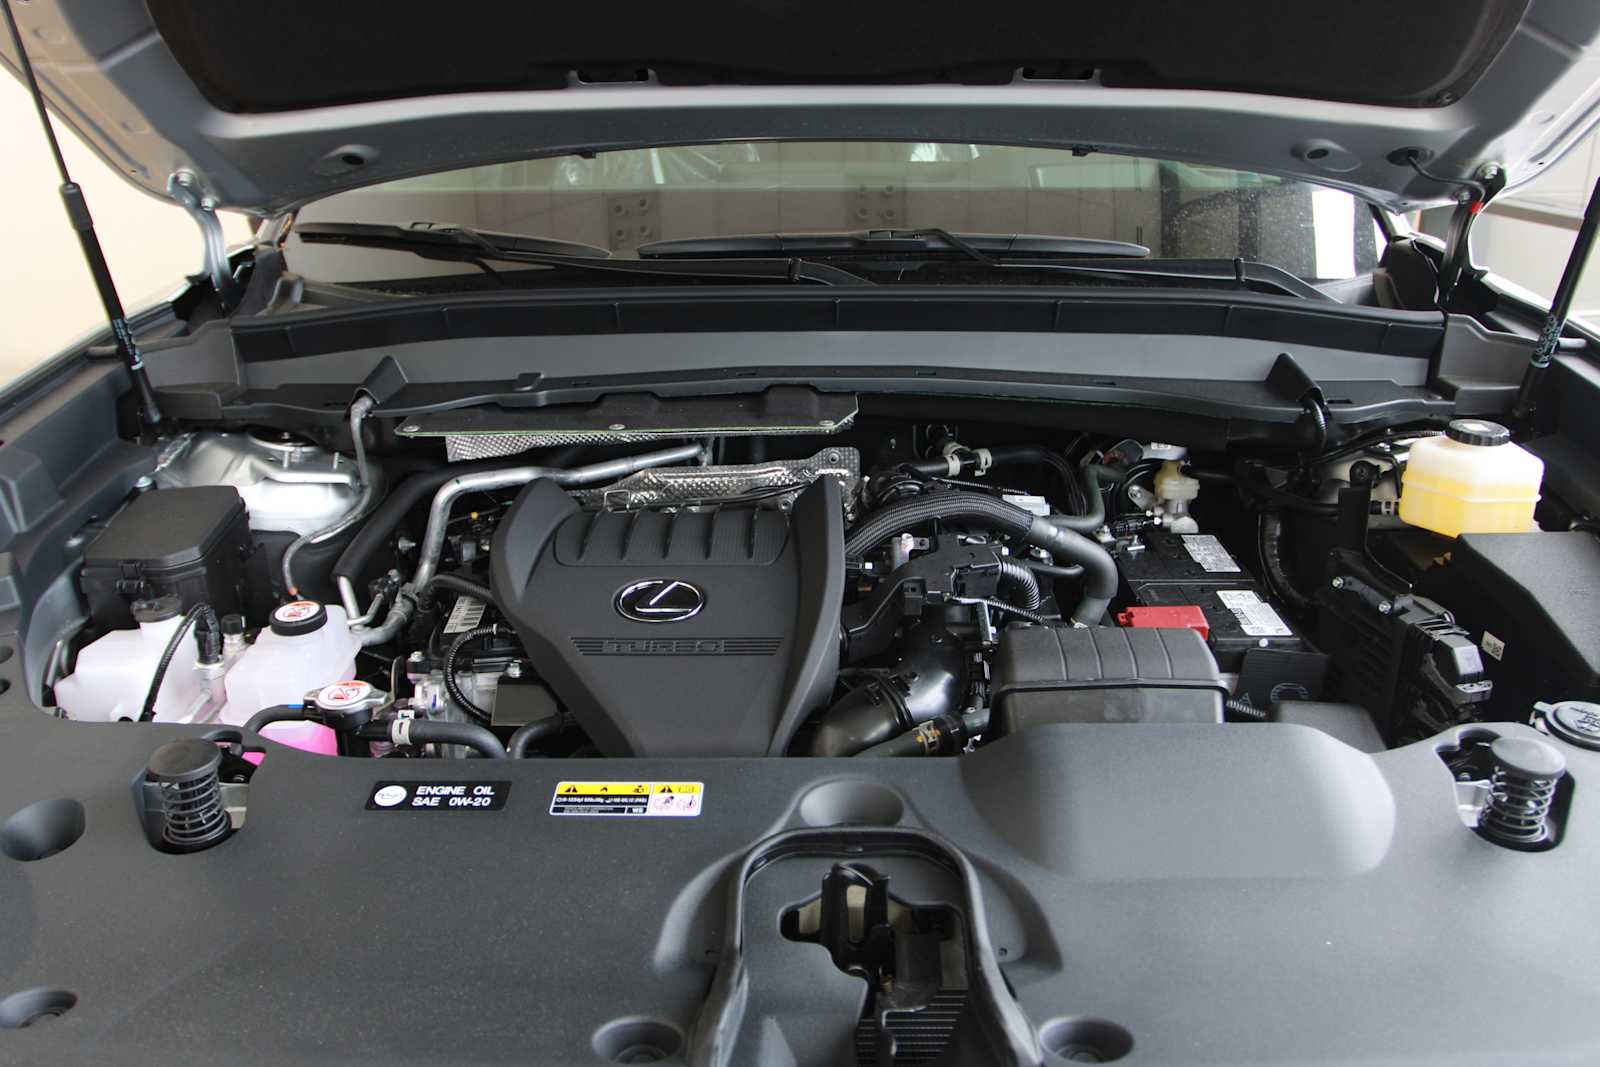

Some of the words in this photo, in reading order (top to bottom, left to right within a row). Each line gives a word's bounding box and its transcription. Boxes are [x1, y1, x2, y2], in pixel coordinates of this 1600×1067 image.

[605, 639, 724, 653] TURBO
[416, 786, 466, 795] ENGINE
[473, 786, 495, 795] OIL
[412, 797, 440, 806] SAE
[448, 797, 491, 806] 0W-20
